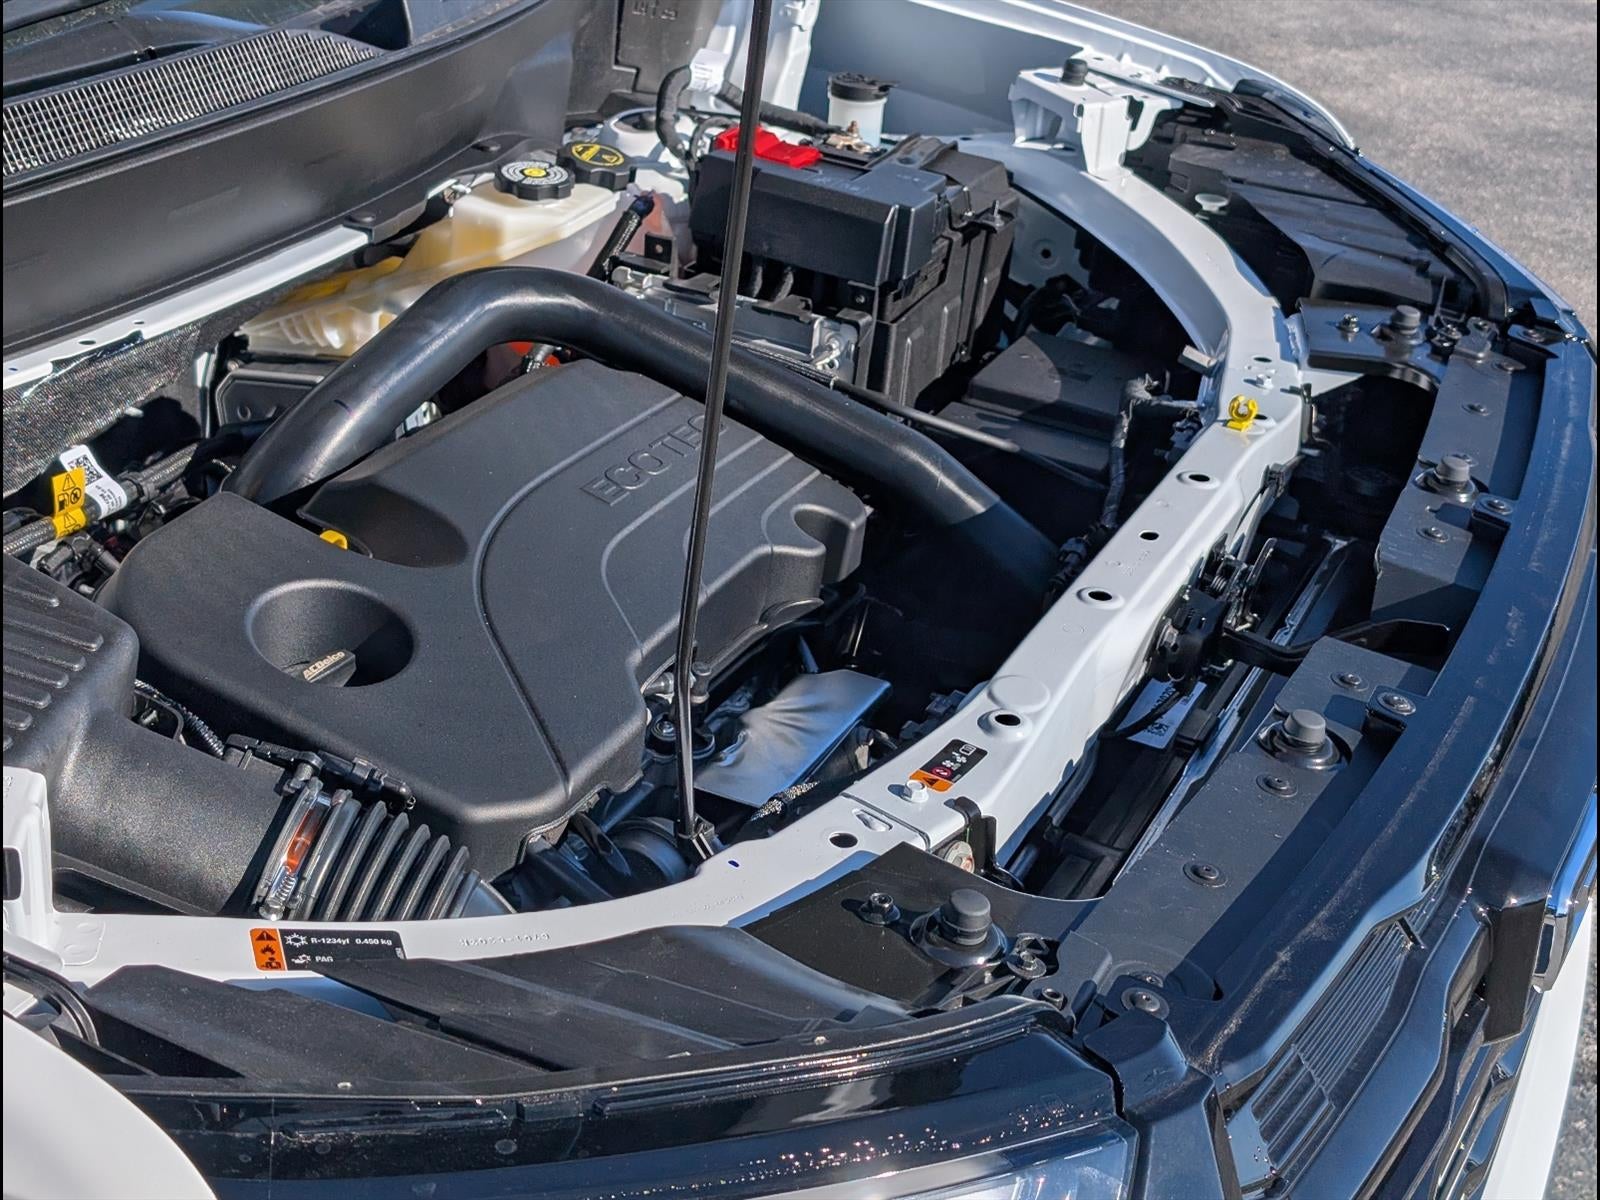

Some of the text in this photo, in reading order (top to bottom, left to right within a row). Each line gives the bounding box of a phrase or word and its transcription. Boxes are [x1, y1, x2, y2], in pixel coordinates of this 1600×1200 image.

[303, 651, 346, 680] ACDelco
[310, 937, 393, 946] R-1234yf 0.450 kg
